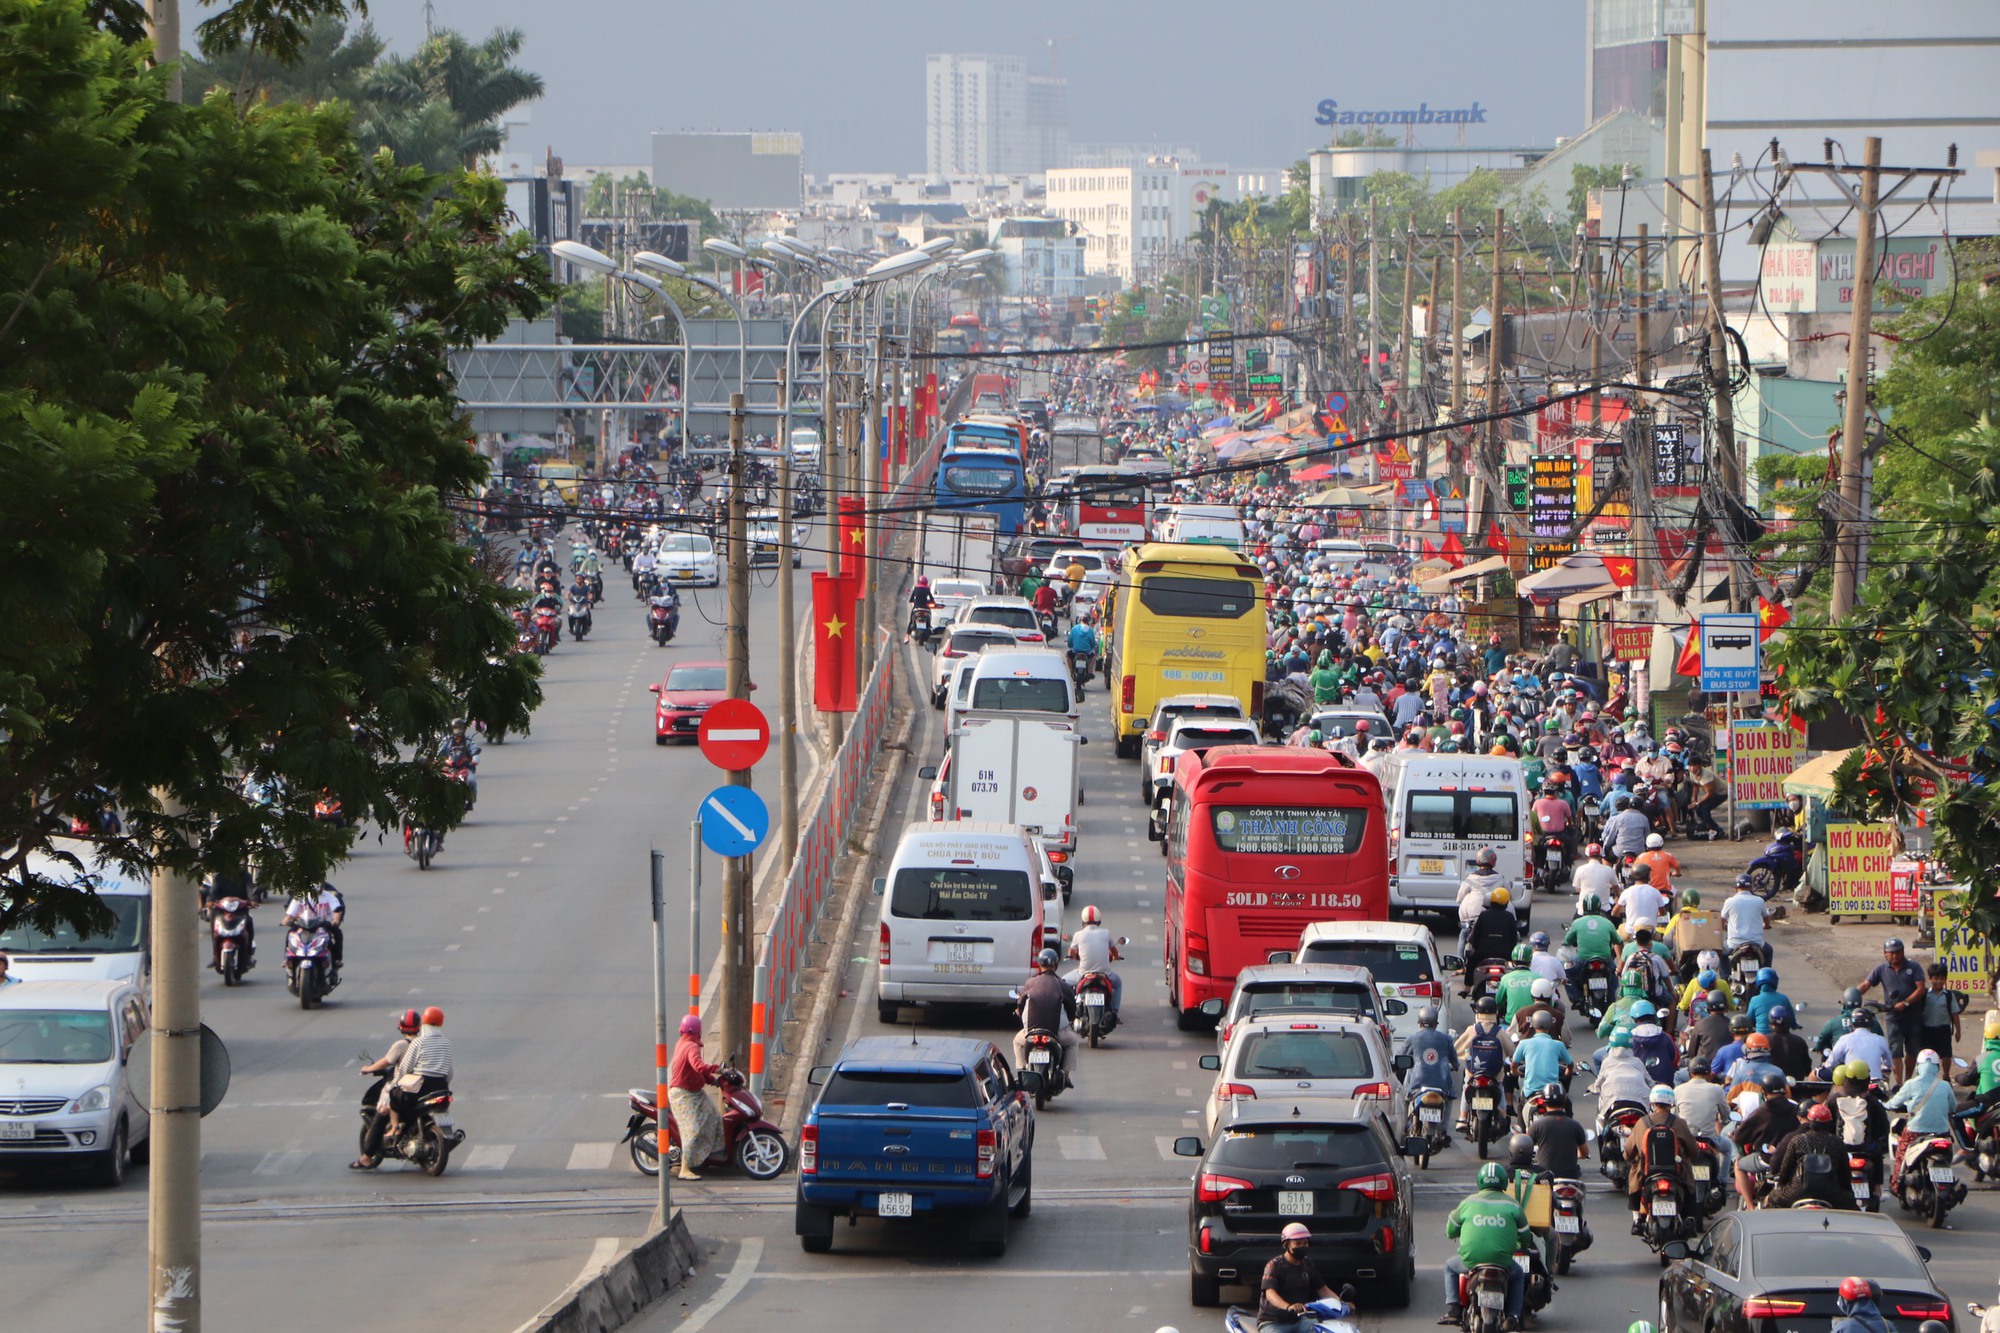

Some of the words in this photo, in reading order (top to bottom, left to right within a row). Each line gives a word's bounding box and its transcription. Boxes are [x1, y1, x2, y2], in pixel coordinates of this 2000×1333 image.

[1315, 99, 1487, 126] Sacombank
[1878, 244, 1937, 280] NGHỈ
[1535, 462, 1552, 472] MUA
[1554, 460, 1570, 472] BÁN
[1535, 494, 1555, 504] iPhone
[1558, 494, 1571, 504] iPad
[1535, 510, 1570, 520] LAPTOP
[1616, 630, 1638, 647] CHÈ
[1163, 644, 1226, 659] mobihome
[1618, 647, 1639, 659] BÌNH
[1163, 669, 1182, 679] 48B
[1191, 671, 1224, 681] 007.91
[1703, 669, 1720, 679] BẾN
[1735, 669, 1757, 678] BUÝT
[1710, 681, 1726, 689] BUS
[1728, 681, 1750, 689] STOP
[1735, 729, 1767, 751] BÚN
[1736, 754, 1751, 775] MÌ
[1753, 751, 1793, 777] QUẢNG
[979, 770, 993, 780] 61H
[1426, 771, 1495, 779] LUXURY
[971, 782, 998, 793] 073.79
[1737, 779, 1757, 801] BÚN
[1760, 776, 1779, 800] CHẢ
[1249, 809, 1272, 817] CÔNG
[1309, 810, 1326, 818] VẬN
[1328, 809, 1341, 817] TẢI
[1239, 816, 1299, 835] THÀNH
[1302, 817, 1347, 836] CÔNG
[1830, 826, 1852, 848] MỞ
[1236, 842, 1284, 853] 1900.6962
[1296, 843, 1345, 853] 1900.6952
[927, 849, 951, 858] CHÙA
[954, 851, 978, 859] PHẬT
[1830, 852, 1858, 872] LÀM
[1863, 852, 1892, 872] CHÌA
[1830, 874, 1848, 897] CẮT
[1850, 877, 1872, 897] CHÌA
[1226, 892, 1268, 906] 50LD
[1310, 893, 1362, 907] 118.50
[1831, 900, 1842, 911] ĐT:
[1844, 900, 1859, 911] 090
[1861, 900, 1875, 910] 832
[1877, 900, 1891, 910] 437
[954, 944, 967, 952] 51B
[1400, 952, 1419, 960] Grab
[822, 1160, 972, 1174] RANGER
[887, 1194, 904, 1203] 51D
[1287, 1193, 1305, 1202] 51A
[880, 1204, 911, 1215] 456.92
[1280, 1204, 1312, 1214] 992.17
[1473, 1214, 1507, 1227] Grab
